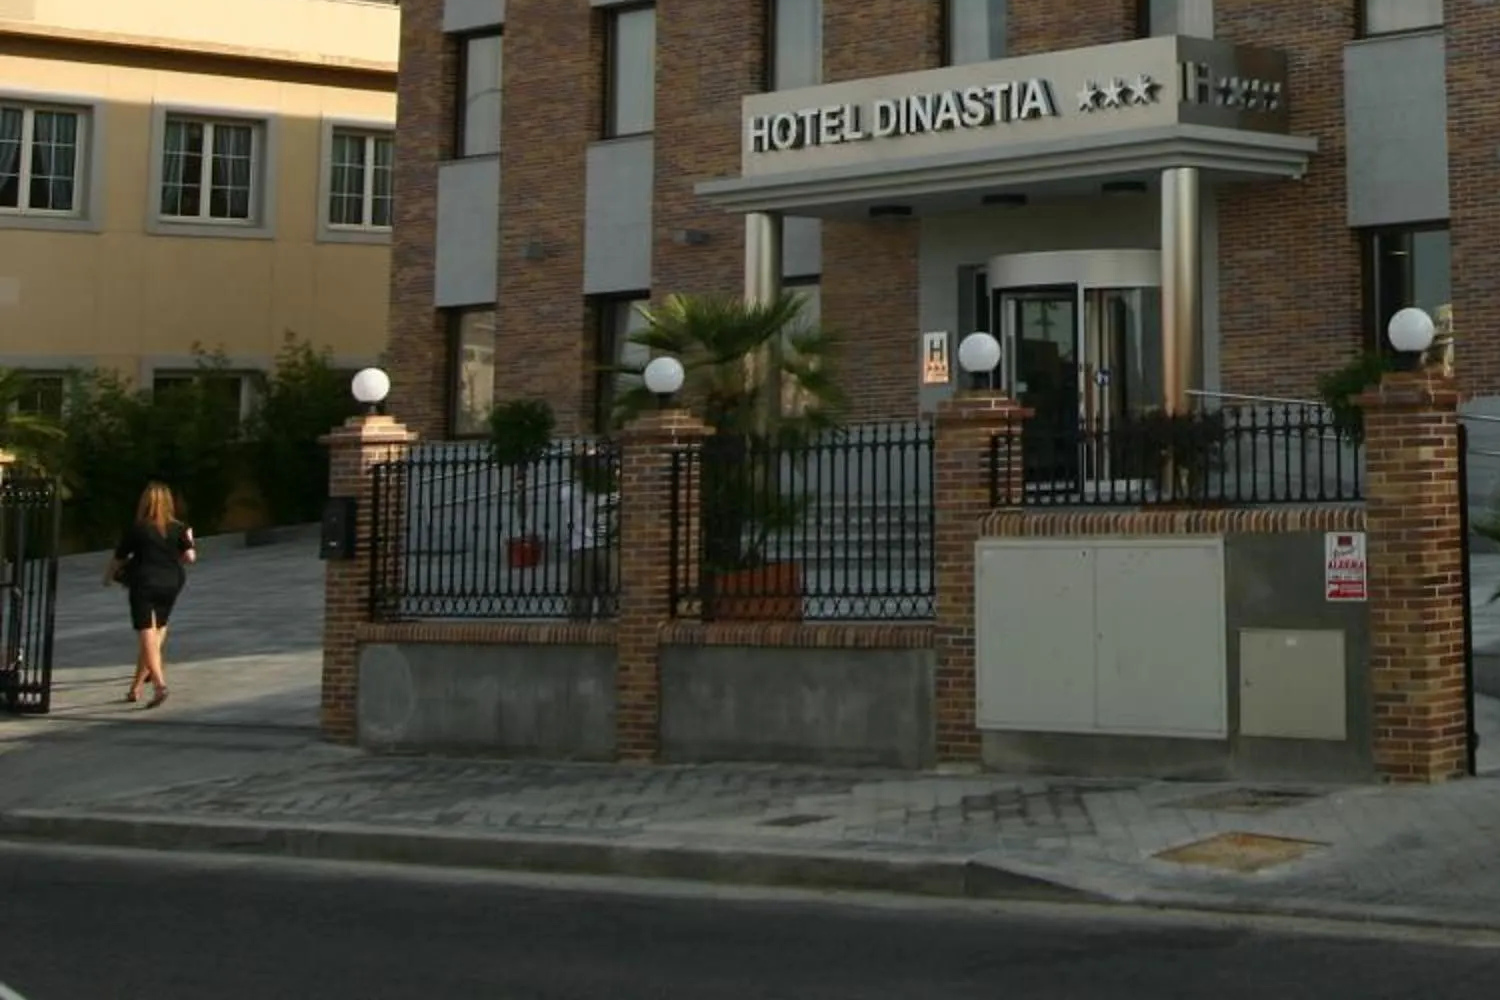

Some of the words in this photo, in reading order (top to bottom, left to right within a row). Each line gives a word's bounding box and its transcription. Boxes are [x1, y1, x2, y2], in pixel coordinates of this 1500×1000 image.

[749, 103, 863, 151] HOTEL
[873, 77, 1054, 138] DINASTIA
[929, 339, 944, 362] H
